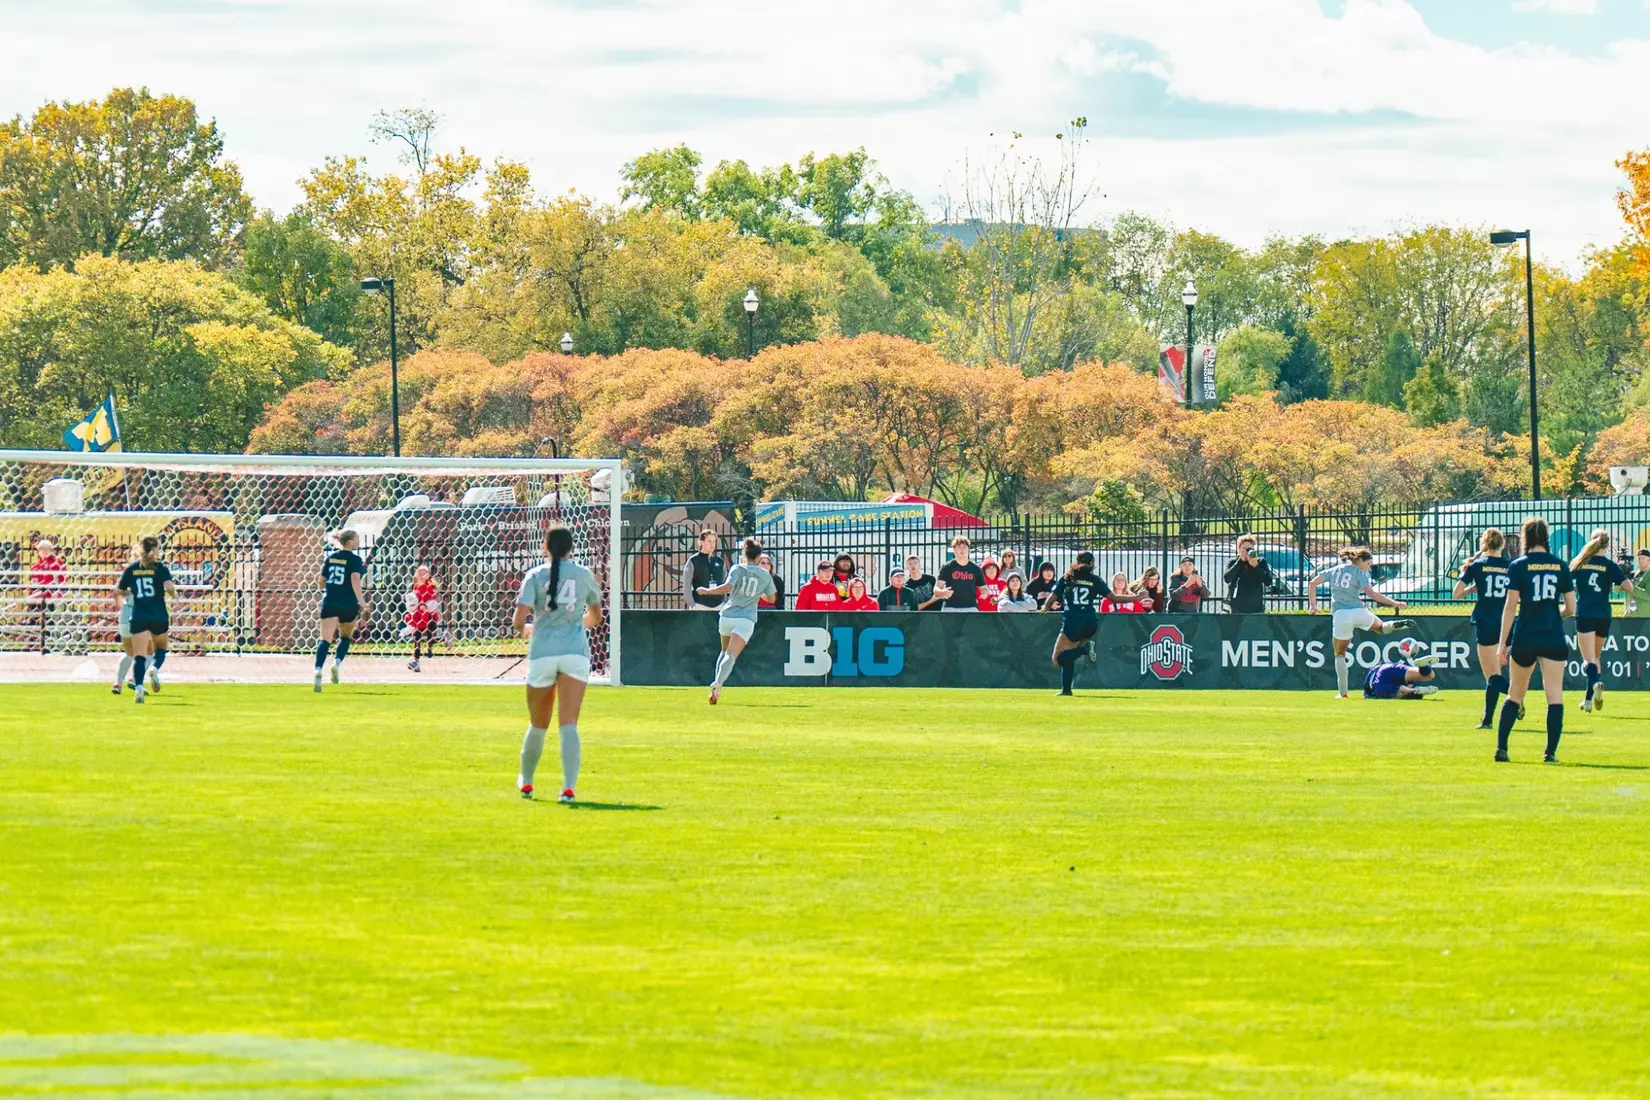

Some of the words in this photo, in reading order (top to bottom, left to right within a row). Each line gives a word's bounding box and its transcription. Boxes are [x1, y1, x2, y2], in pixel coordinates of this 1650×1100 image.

[1207, 350, 1216, 399] DEFEND
[586, 518, 630, 528] Chicen
[807, 515, 846, 526] FUNNEL
[849, 512, 877, 523] CAKE
[881, 508, 924, 520] STATION
[326, 565, 346, 585] 25
[952, 570, 974, 580] Ohio
[1334, 568, 1353, 589] 18
[1588, 572, 1602, 592] 4
[136, 577, 155, 598] 15
[739, 576, 759, 597] 10
[1072, 587, 1090, 605] 12
[1484, 574, 1507, 598] 19
[1532, 574, 1558, 602] 16
[1221, 640, 1326, 668] MEN'S
[1606, 661, 1632, 678] '01
